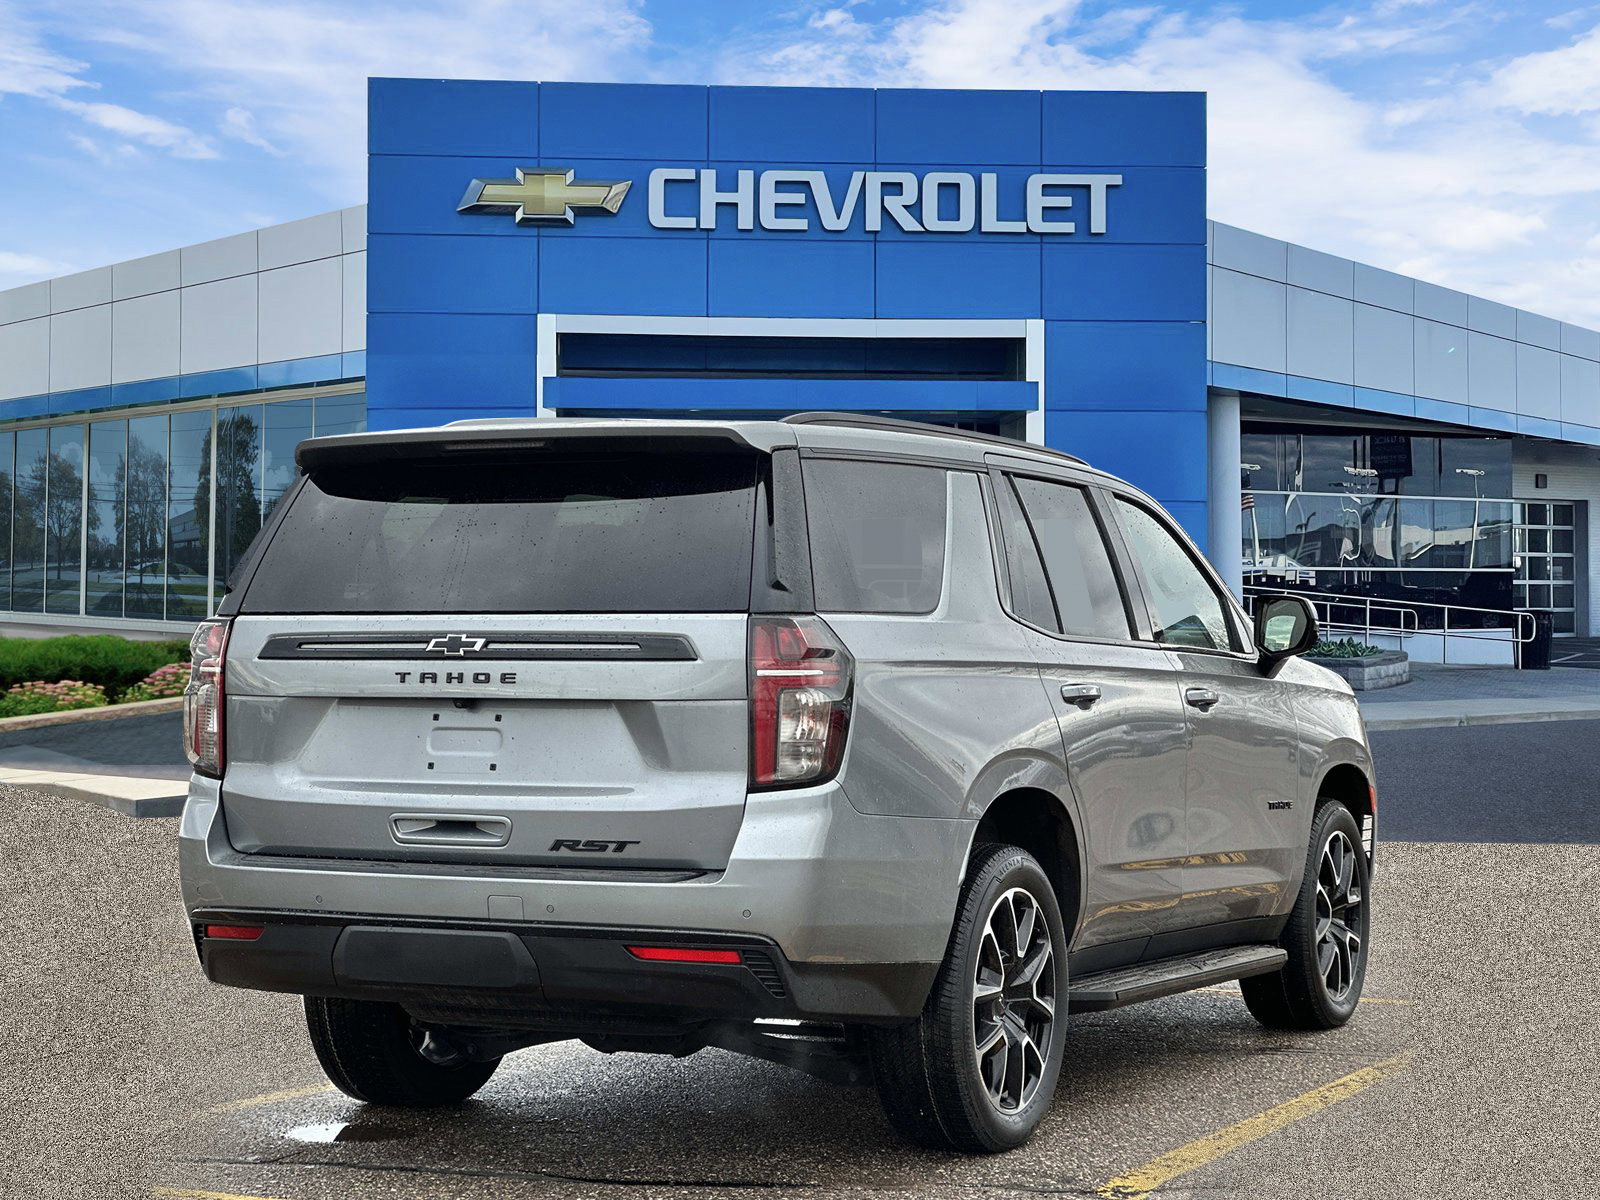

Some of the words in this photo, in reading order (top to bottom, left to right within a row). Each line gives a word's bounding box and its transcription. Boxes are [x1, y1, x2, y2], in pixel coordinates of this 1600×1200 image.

[648, 168, 1122, 234] CHEVROLET
[395, 672, 517, 684] TAHOE
[548, 839, 641, 853] RST
